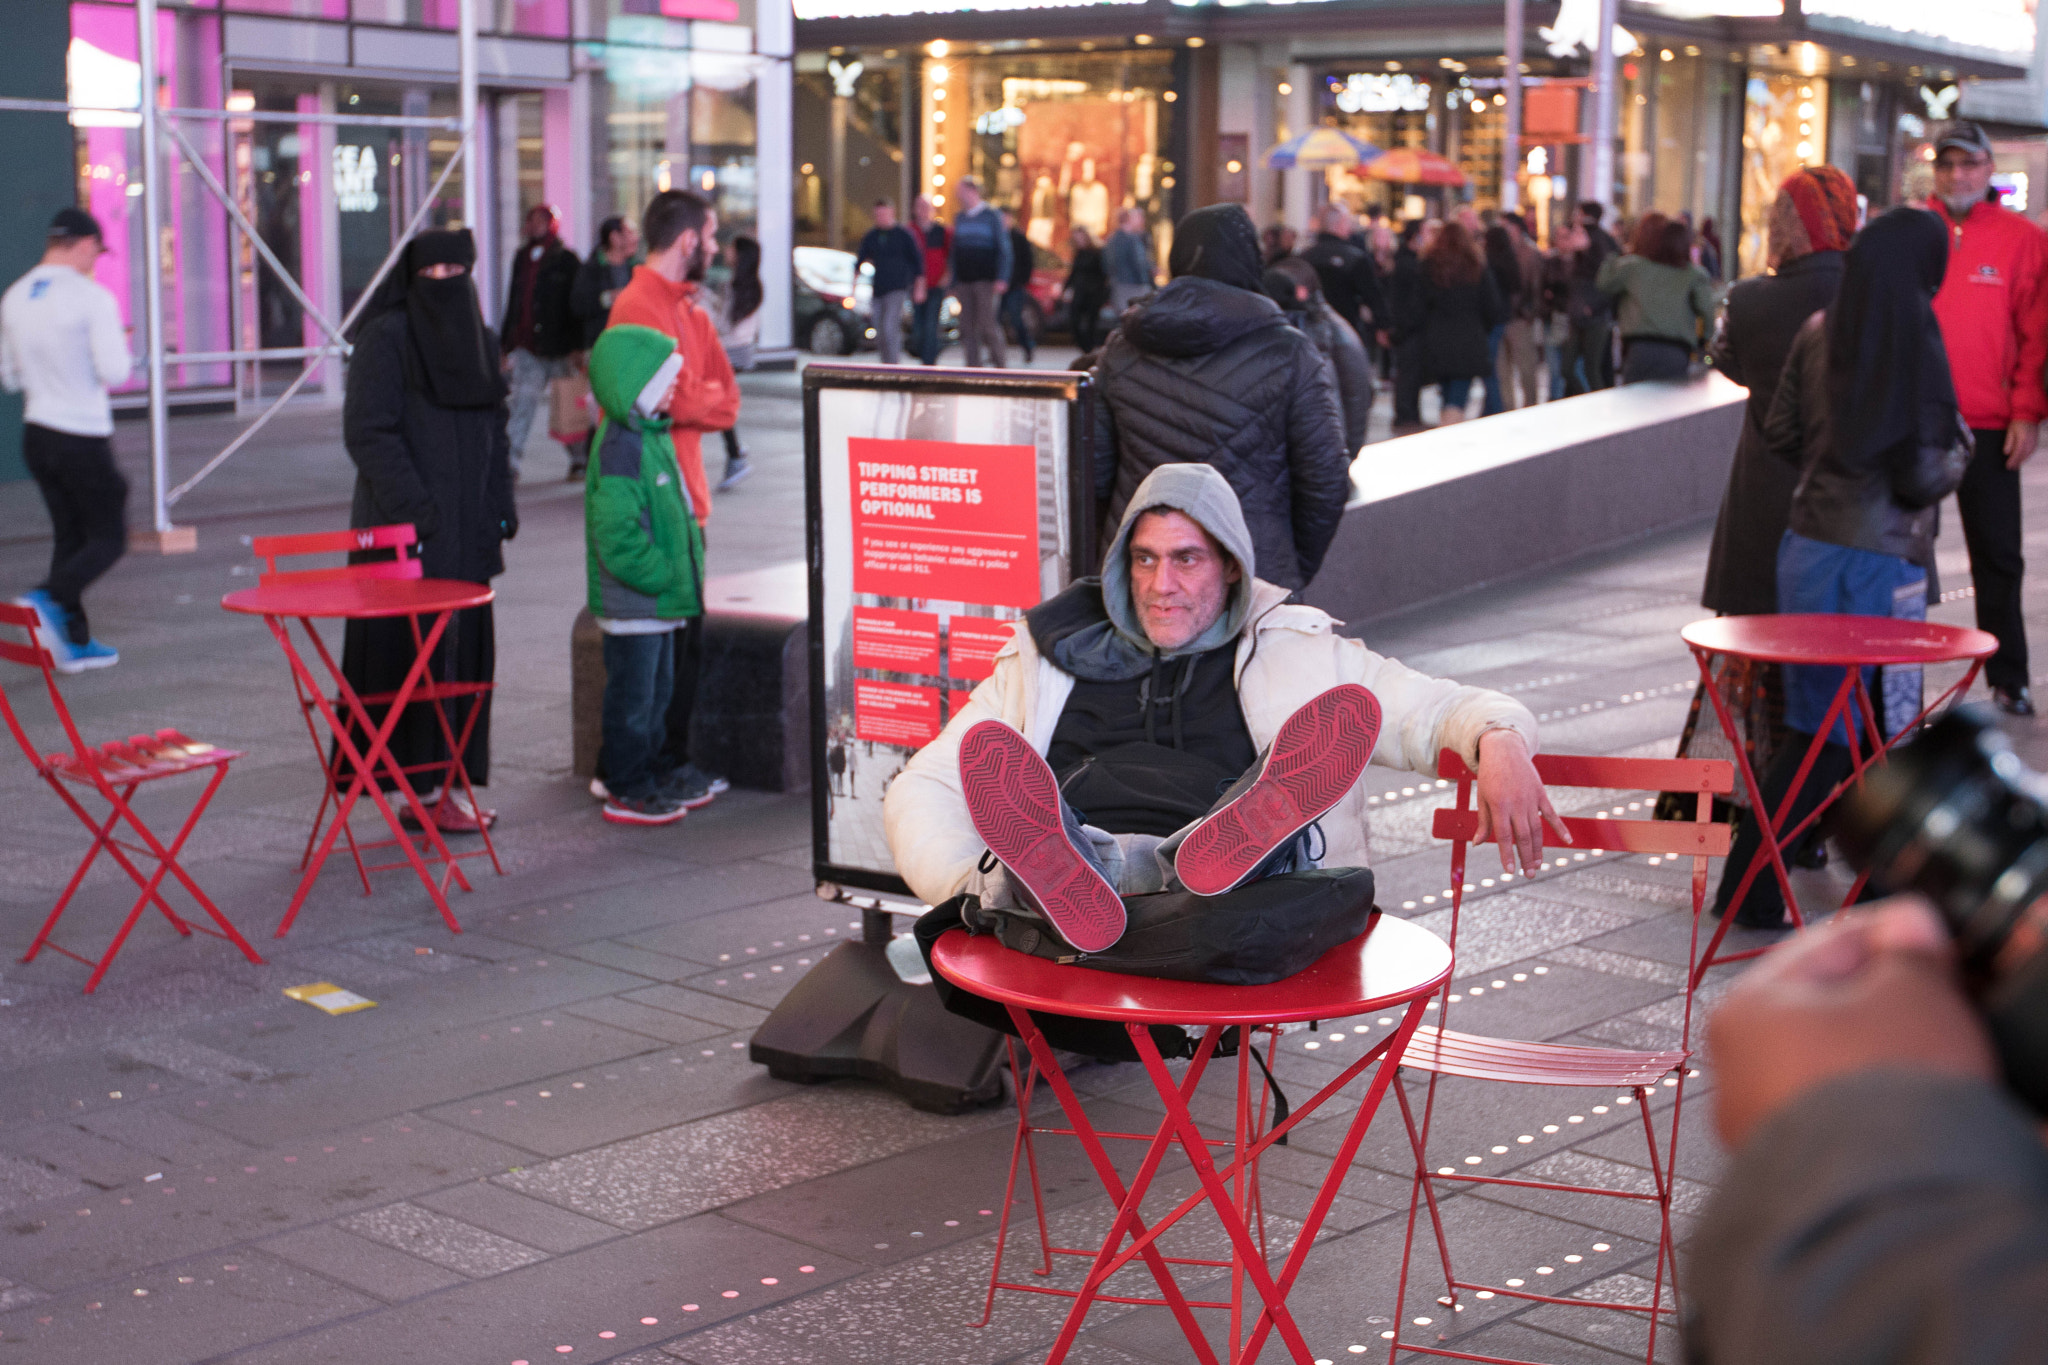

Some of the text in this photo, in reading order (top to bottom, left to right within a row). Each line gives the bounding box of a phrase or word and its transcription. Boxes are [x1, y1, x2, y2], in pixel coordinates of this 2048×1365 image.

[858, 461, 978, 485] TIPPING STREET
[859, 480, 982, 504] PERFORMERS IS
[861, 499, 935, 519] OPTIONAL
[870, 539, 884, 549] you
[885, 540, 898, 549] see
[900, 541, 908, 550] or
[909, 542, 949, 553] experience
[951, 545, 965, 556] any
[967, 547, 1008, 558] aggressive
[1009, 550, 1018, 559] or
[863, 549, 912, 561] inappropriate
[948, 556, 977, 567] contact
[978, 560, 985, 568] a
[986, 559, 1010, 570] police
[863, 559, 888, 570] officer
[889, 563, 897, 571] or
[898, 562, 912, 572] call
